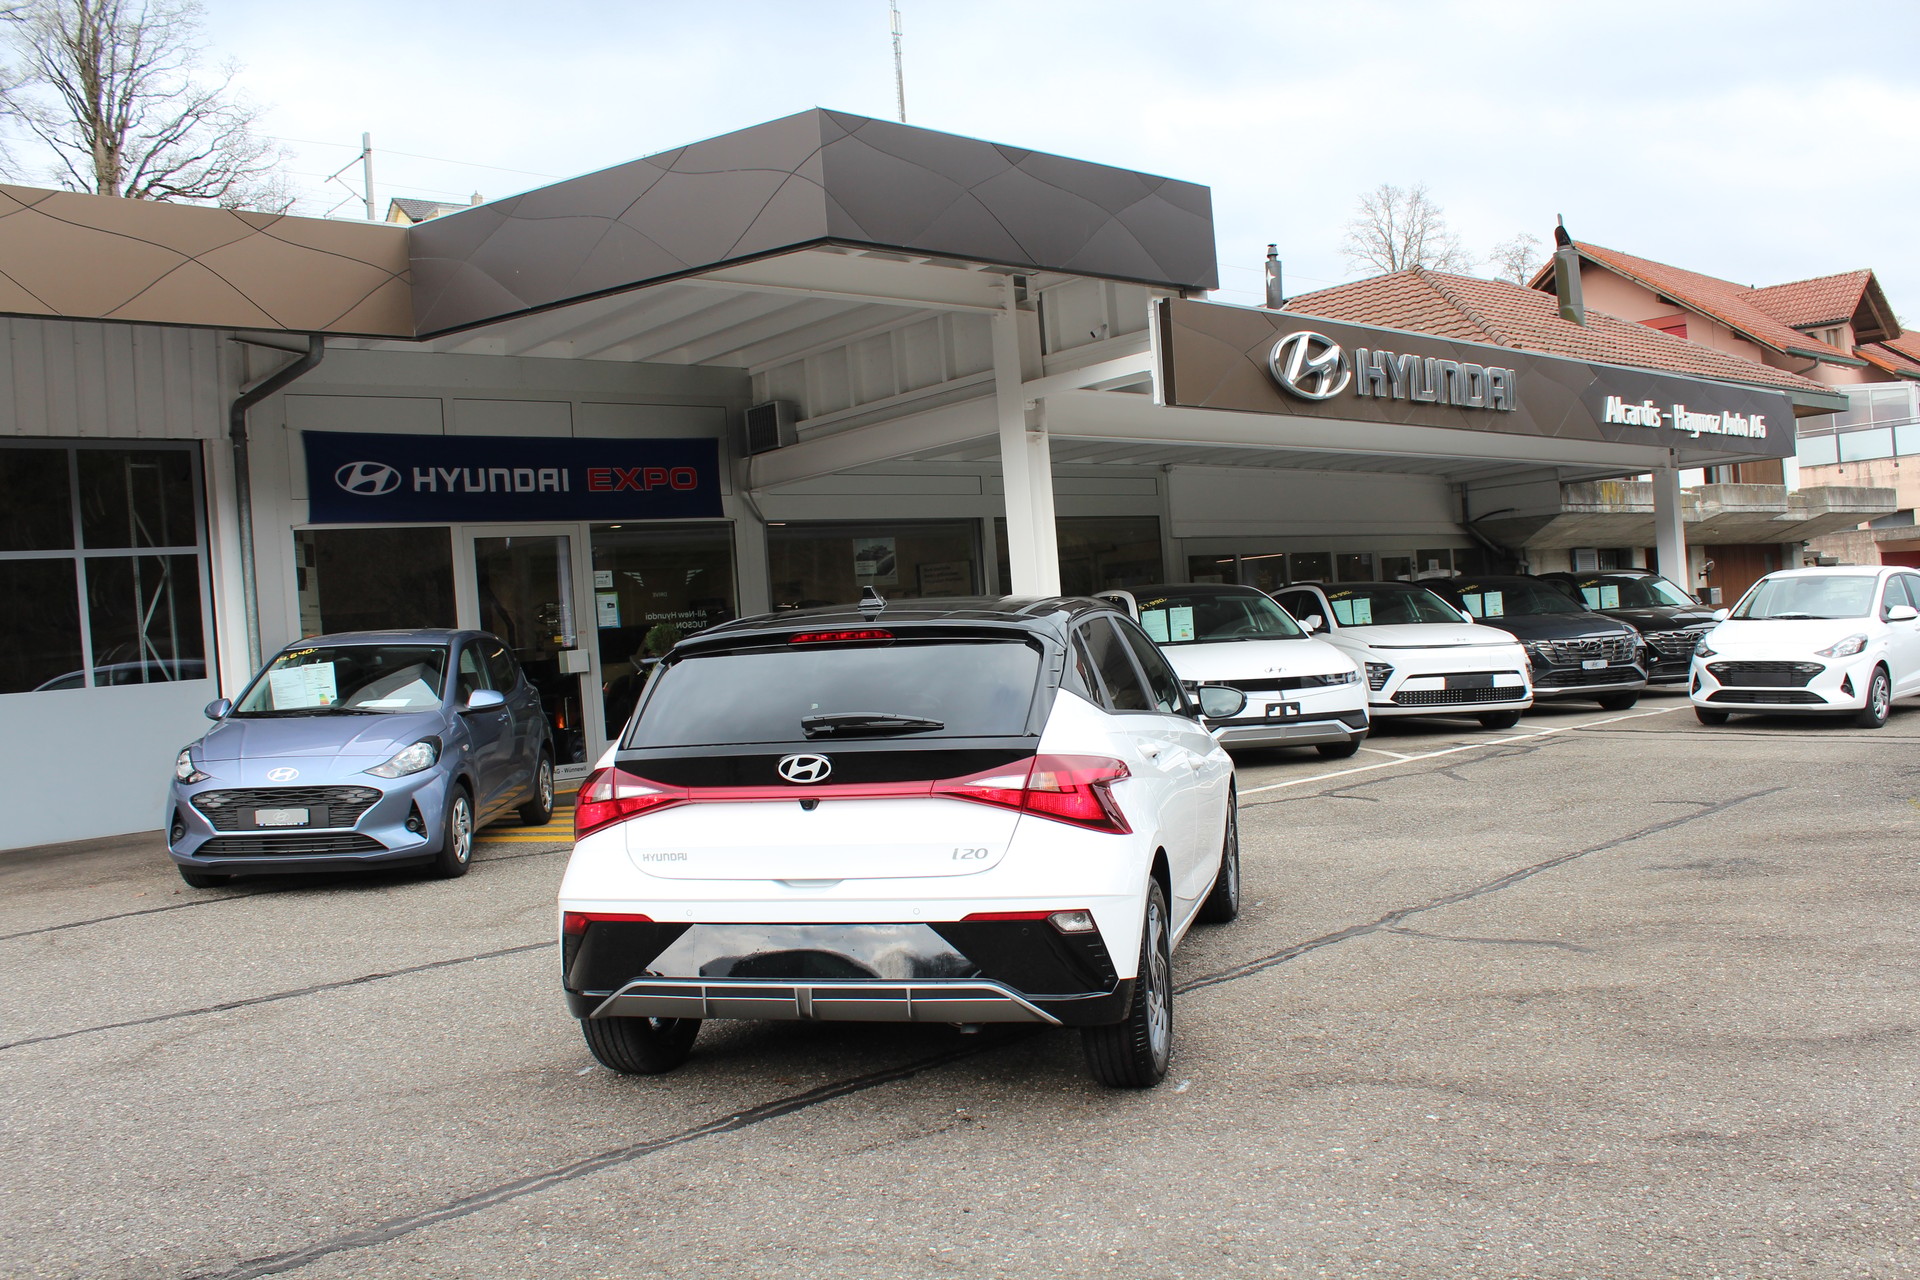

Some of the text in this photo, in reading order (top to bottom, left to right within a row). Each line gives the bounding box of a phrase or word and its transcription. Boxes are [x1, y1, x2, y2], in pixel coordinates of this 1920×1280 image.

[1355, 347, 1517, 412] HYUNDAI
[1604, 395, 1661, 428] Alcardis
[1673, 404, 1722, 439] Haymoz
[1722, 410, 1749, 438] Auto
[1749, 414, 1766, 439] AG
[413, 466, 698, 493] HYUNDAI EXPO
[642, 852, 688, 862] HYUNDAI
